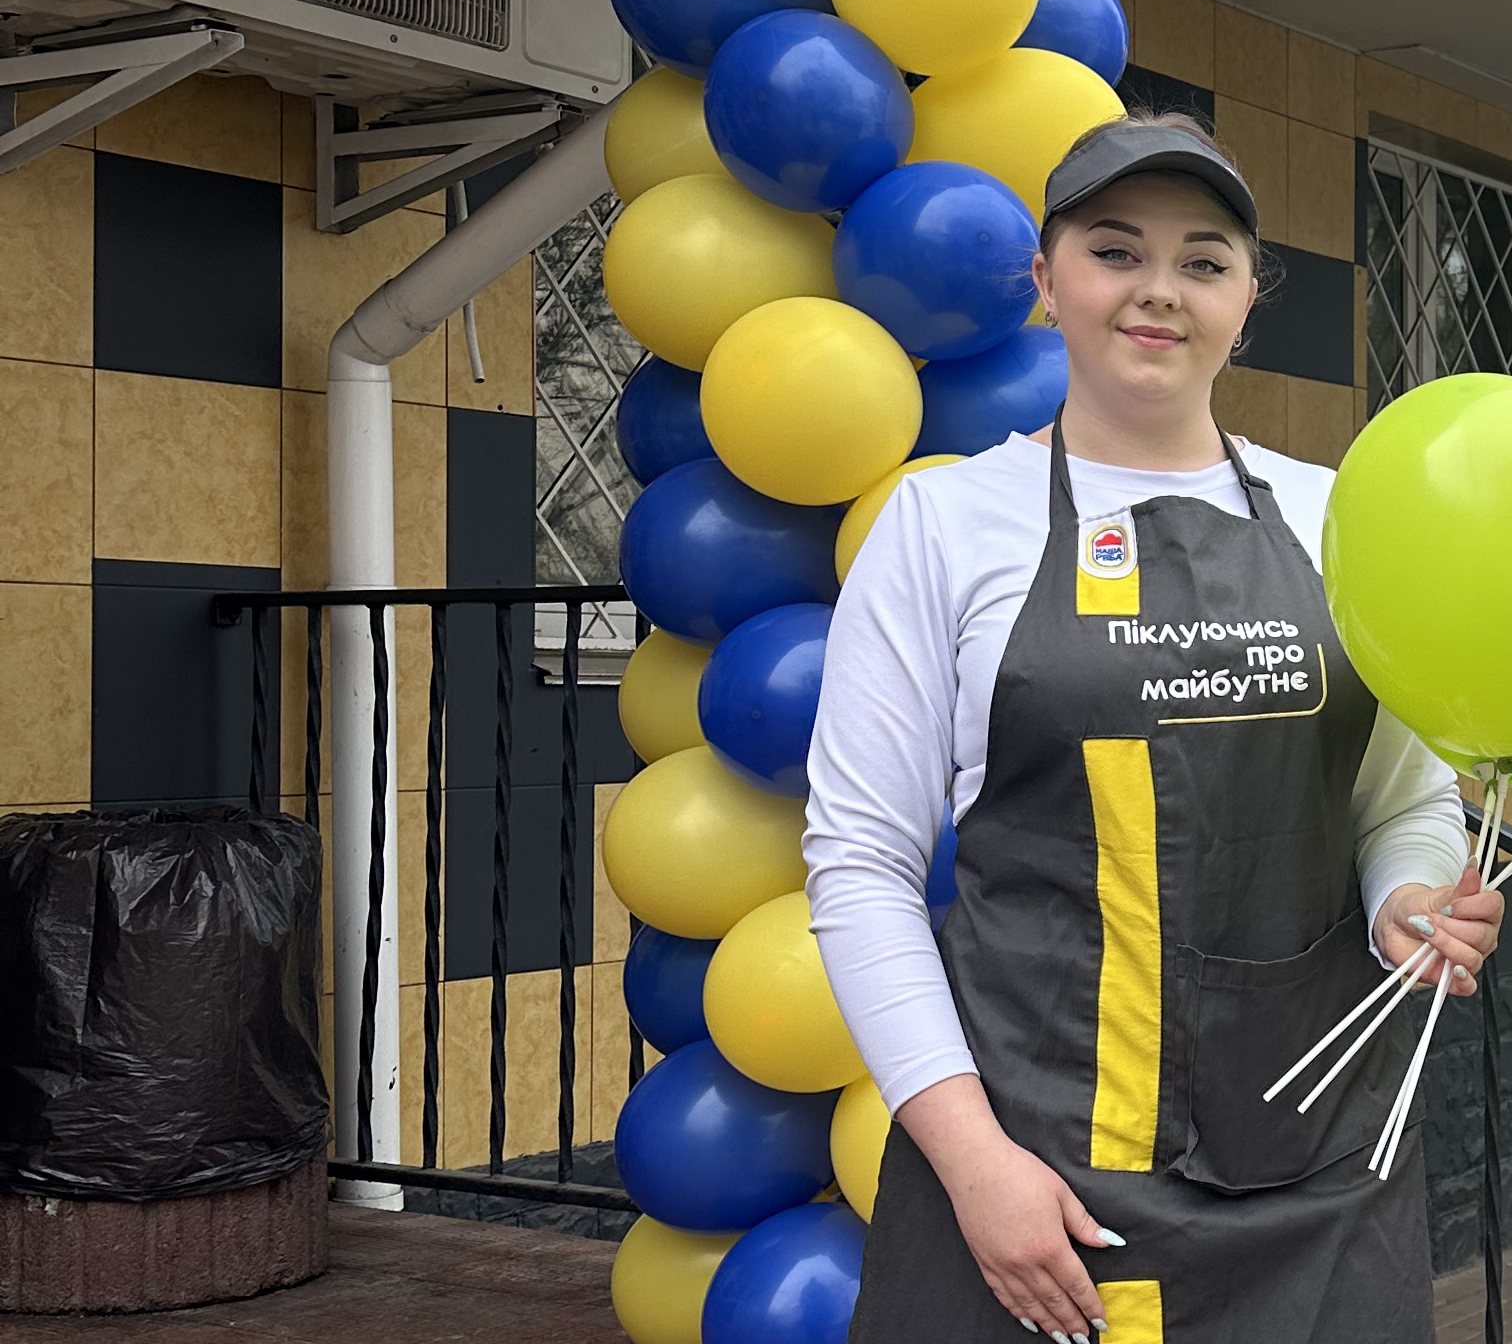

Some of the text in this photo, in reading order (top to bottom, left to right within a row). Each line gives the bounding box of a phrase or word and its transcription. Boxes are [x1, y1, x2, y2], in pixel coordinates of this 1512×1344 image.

[1108, 619, 1299, 649] Піклуючись
[1246, 645, 1305, 671] про
[1141, 669, 1309, 702] майбутнє
